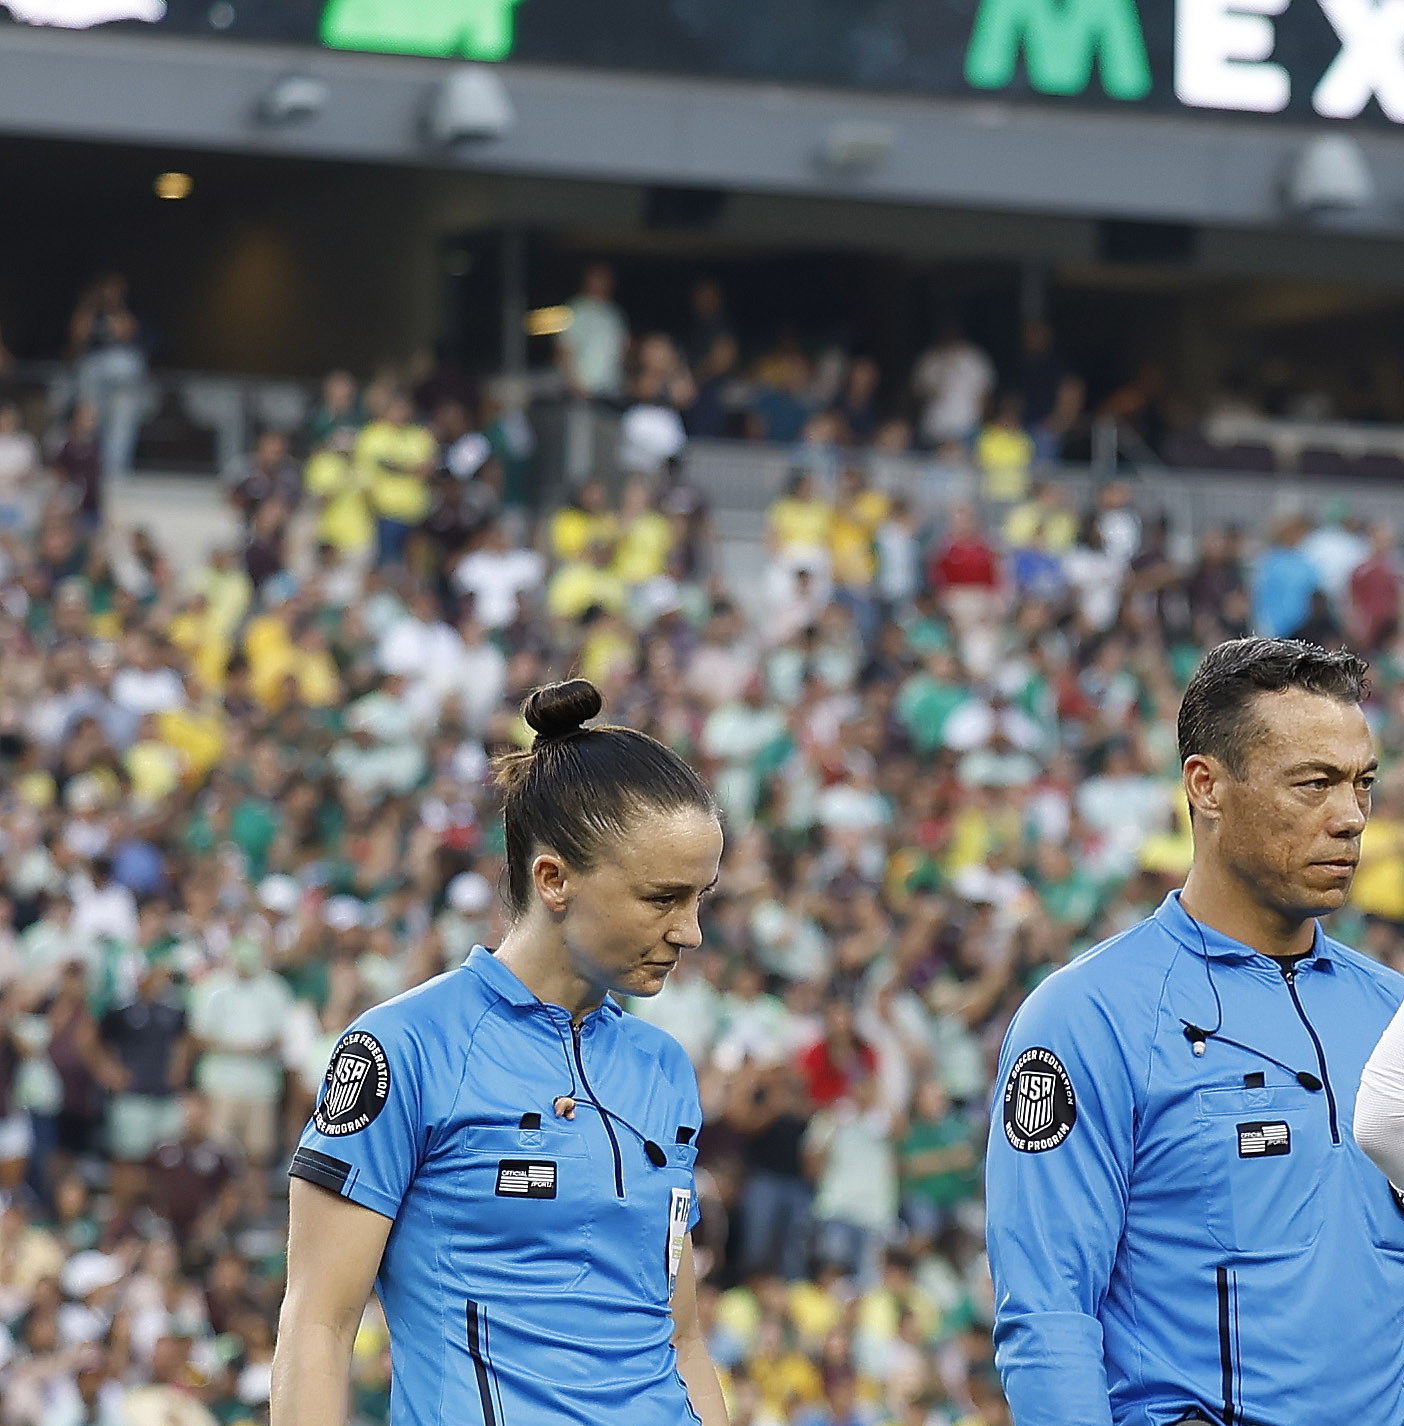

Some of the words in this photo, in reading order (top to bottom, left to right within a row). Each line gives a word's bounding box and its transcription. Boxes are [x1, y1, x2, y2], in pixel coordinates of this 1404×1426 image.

[336, 1057, 367, 1083] USA
[359, 1034, 388, 1098] FEDERATION
[1020, 1075, 1052, 1101] USA
[1027, 1122, 1070, 1151] PROGRAM
